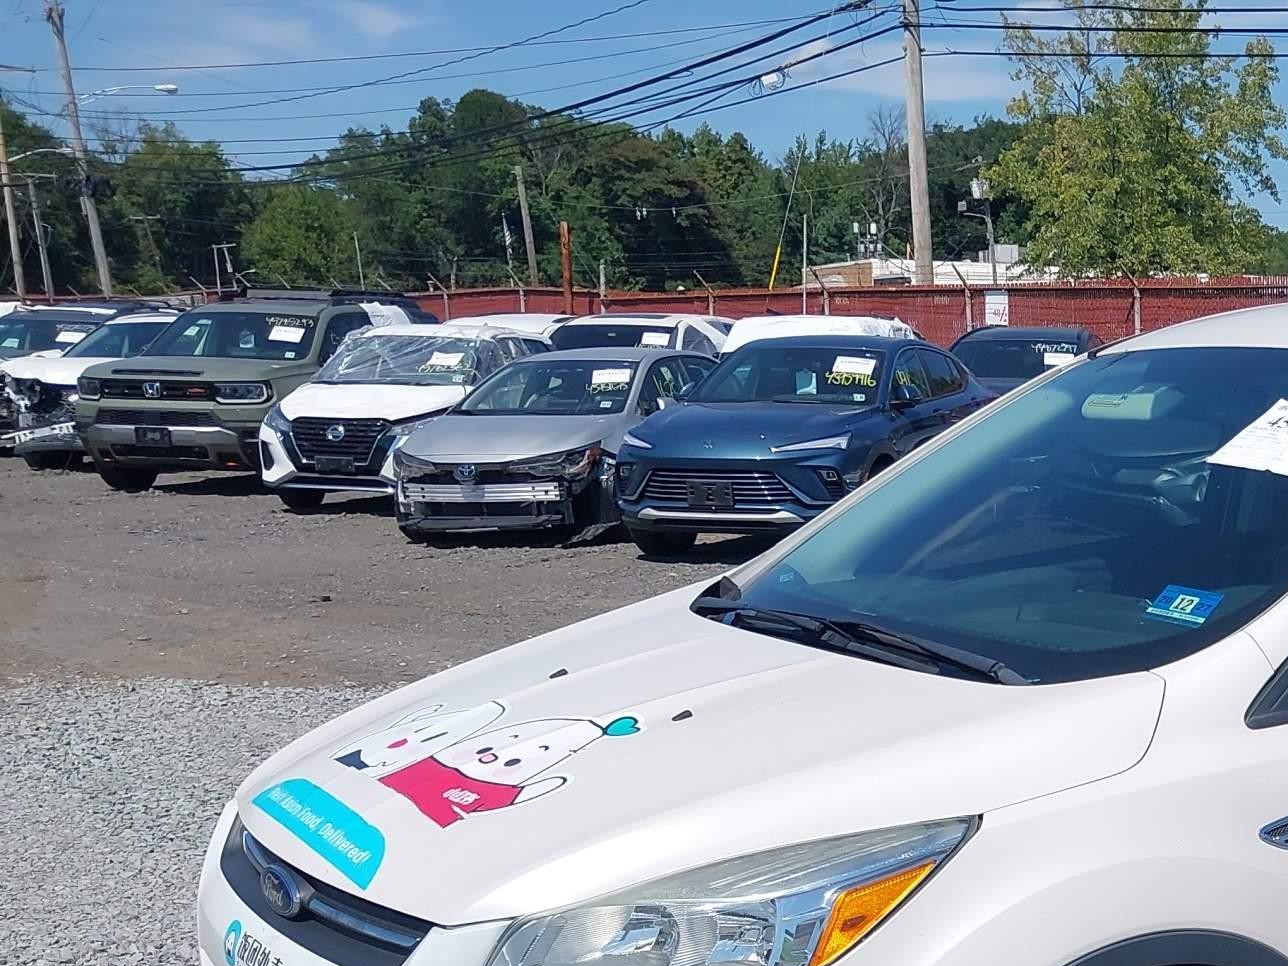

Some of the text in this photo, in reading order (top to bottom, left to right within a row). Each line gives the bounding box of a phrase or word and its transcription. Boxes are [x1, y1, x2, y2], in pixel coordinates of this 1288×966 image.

[1174, 597, 1194, 612] 12
[1195, 602, 1213, 612] 27
[299, 807, 324, 831] Food,
[317, 822, 372, 864] Delivered!
[263, 873, 285, 907] Ford
